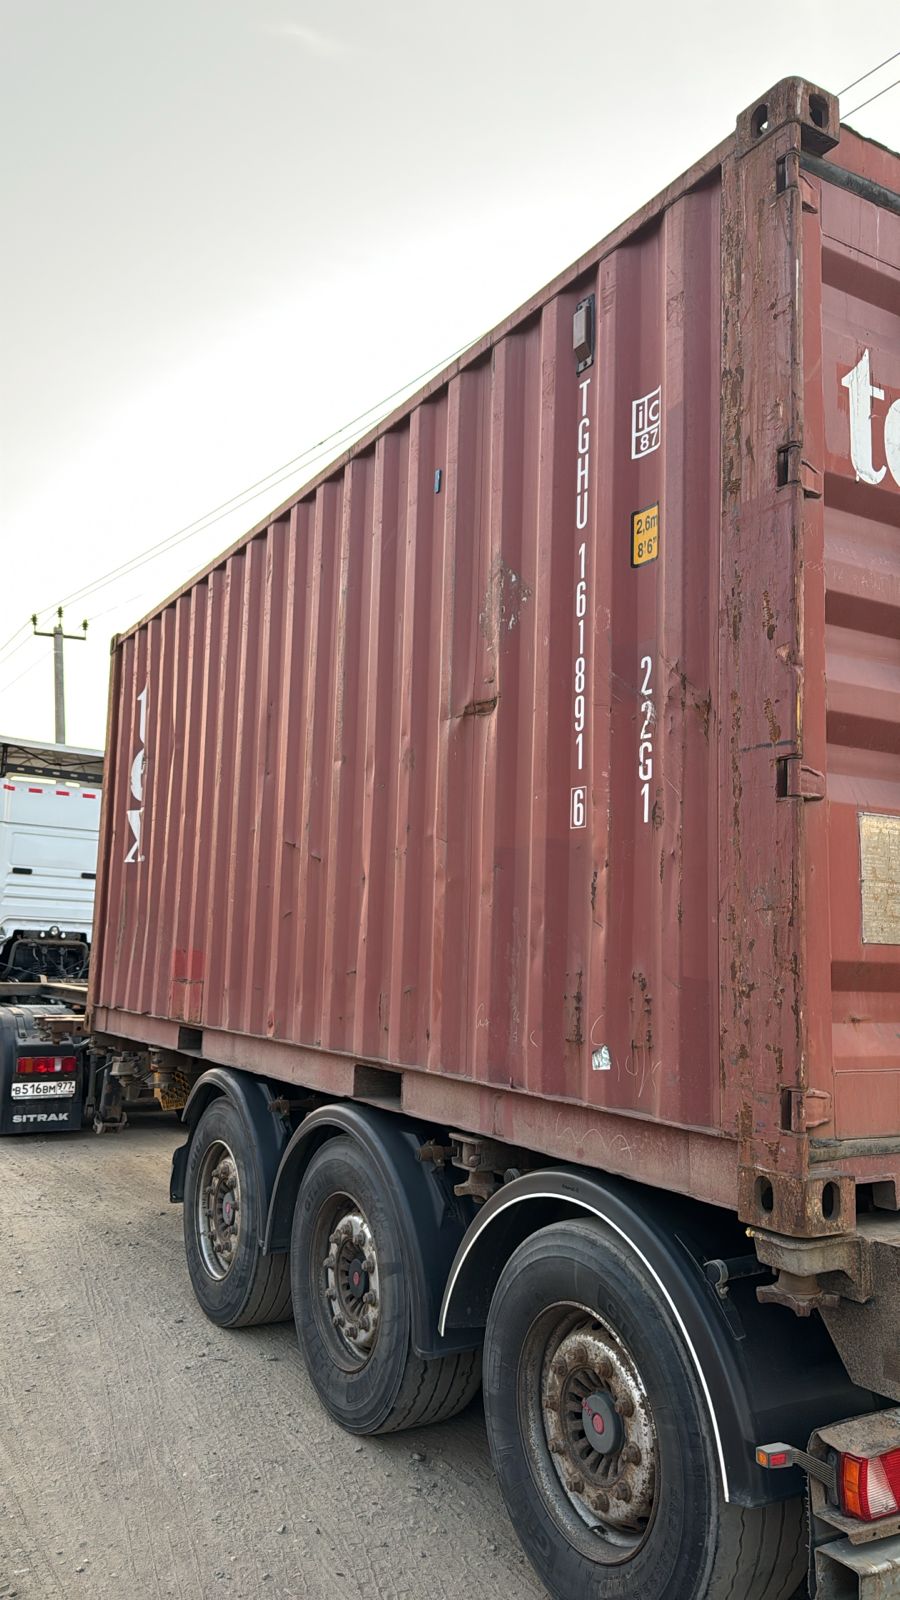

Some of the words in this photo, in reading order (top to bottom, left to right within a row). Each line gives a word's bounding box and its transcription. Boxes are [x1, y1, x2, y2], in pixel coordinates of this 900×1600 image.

[576, 378, 591, 530] TGHU
[640, 428, 659, 452] 87
[574, 542, 587, 770] 161891
[638, 655, 654, 823] 22G1
[573, 789, 584, 826] 6
[12, 1112, 69, 1123] SITRAK
